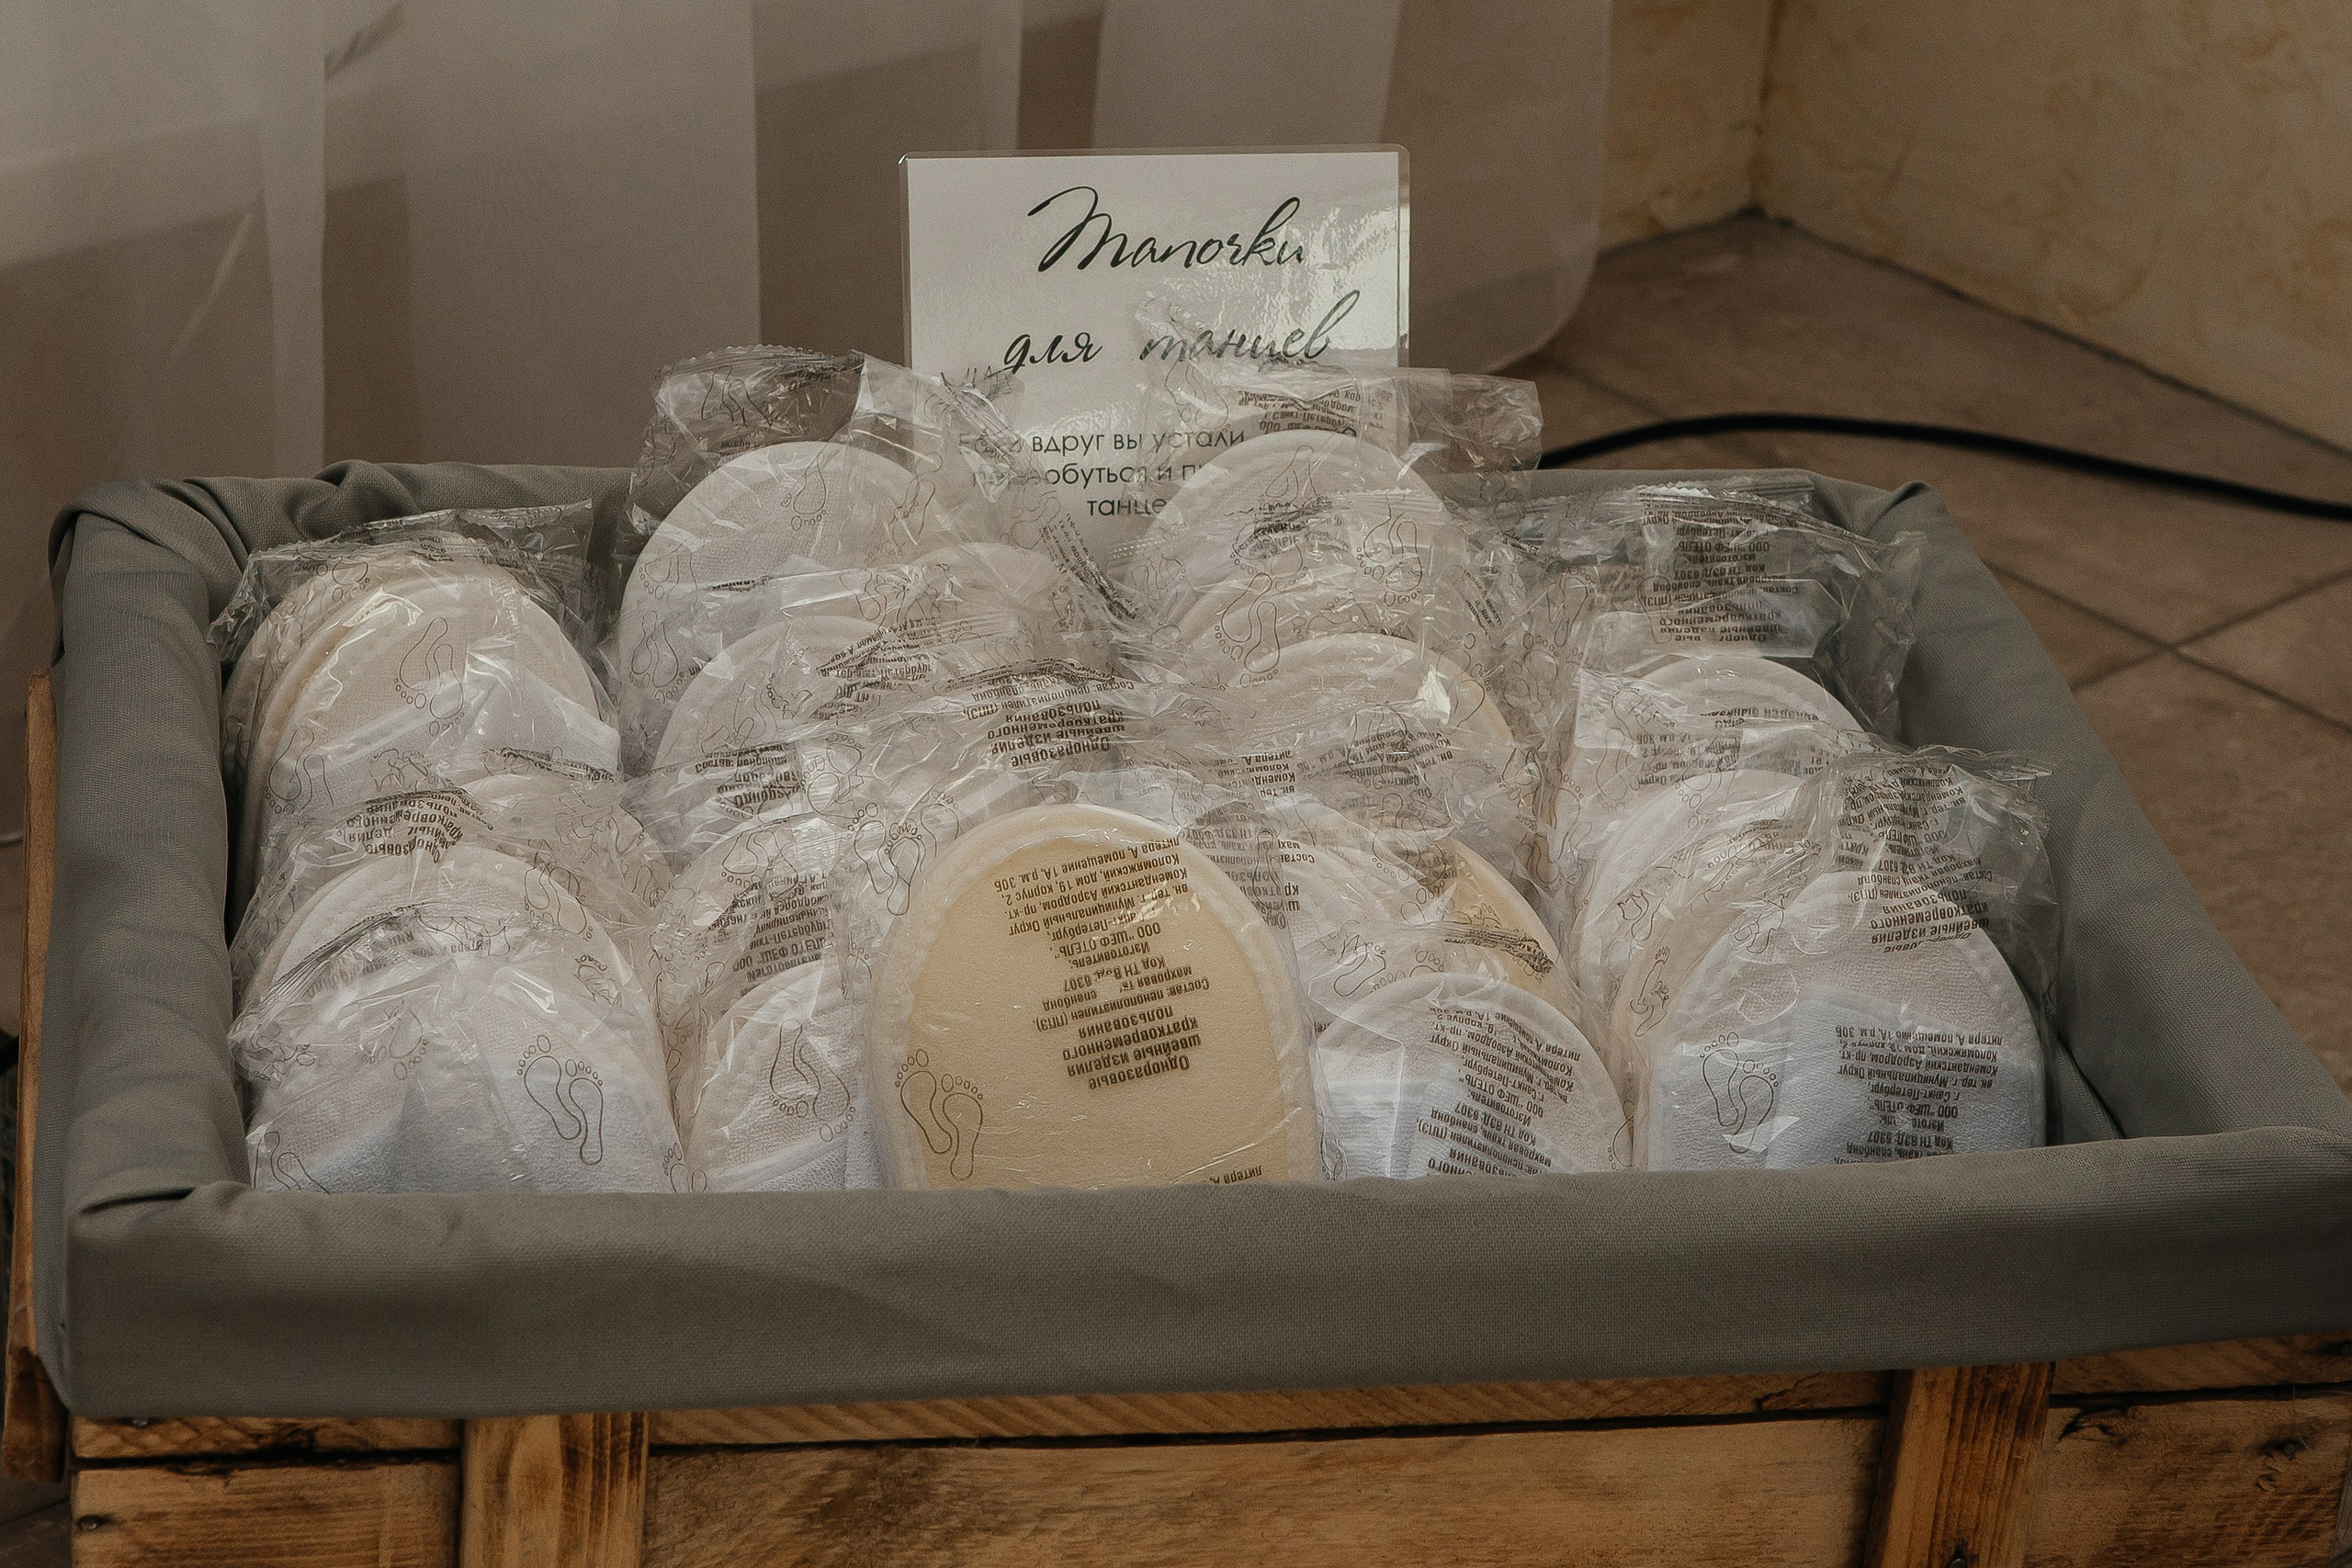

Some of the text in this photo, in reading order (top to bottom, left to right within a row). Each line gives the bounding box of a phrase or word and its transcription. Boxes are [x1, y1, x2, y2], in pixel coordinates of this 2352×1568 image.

[1027, 186, 1303, 272] Тапочки
[1003, 289, 1361, 374] для танцев
[1032, 432, 1104, 457] вдруг
[1114, 434, 1142, 450] вы
[1158, 467, 1172, 481] и
[1087, 499, 1168, 516] танце
[1006, 700, 1101, 724] пользования
[987, 712, 1124, 739] кратковременного
[990, 725, 1125, 755] швейные изделия
[1011, 736, 1111, 768] Одноразовые
[994, 837, 1180, 891] литера А, помещение 1А, р.м. 30Б
[1001, 852, 1180, 907] Коломяжский, дом 19, корпус 2,
[1172, 884, 1189, 895] вн.
[1004, 867, 1188, 919] Комендантский Аэродром, пр-кт.
[1136, 895, 1145, 904] г.
[1883, 889, 1967, 914] пользования
[1042, 897, 1135, 929] Муниципальный
[1871, 901, 1988, 930] кратковременного
[1008, 919, 1040, 937] Округ
[1136, 922, 1160, 939] ООО
[1871, 918, 1989, 944] швейные изделия
[1069, 941, 1150, 970] Изготовитель:
[1063, 955, 1165, 992] Код ТН 6307
[1042, 964, 1193, 1011] махровая спанбонд
[1032, 977, 1209, 1032] Состав: пенополиэтилен (ППЭ),
[1078, 1005, 1173, 1039] пользования
[1836, 1027, 1854, 1038] 30Б
[1858, 1026, 1876, 1038] р.м.
[1878, 1028, 1892, 1041] 1А,
[1062, 1017, 1198, 1061] кратковременного
[1956, 1034, 1965, 1046] А,
[1969, 1032, 2003, 1046] литера
[1066, 1033, 1202, 1077] швейные изделия
[1838, 1050, 1998, 1077] Комендантский Аэродром, пр-кт.
[1088, 1055, 1191, 1090] Одноразовые
[1838, 1065, 1993, 1089] вн. тер. г. Муниципальный Округ
[1868, 1081, 1961, 1102] г. Санкт-Петербург,
[1466, 1089, 1532, 1127] Изготовитель:
[1938, 1105, 1958, 1118] ООО
[1846, 1143, 1892, 1157] спанбонд
[1223, 1165, 1262, 1184] литера
